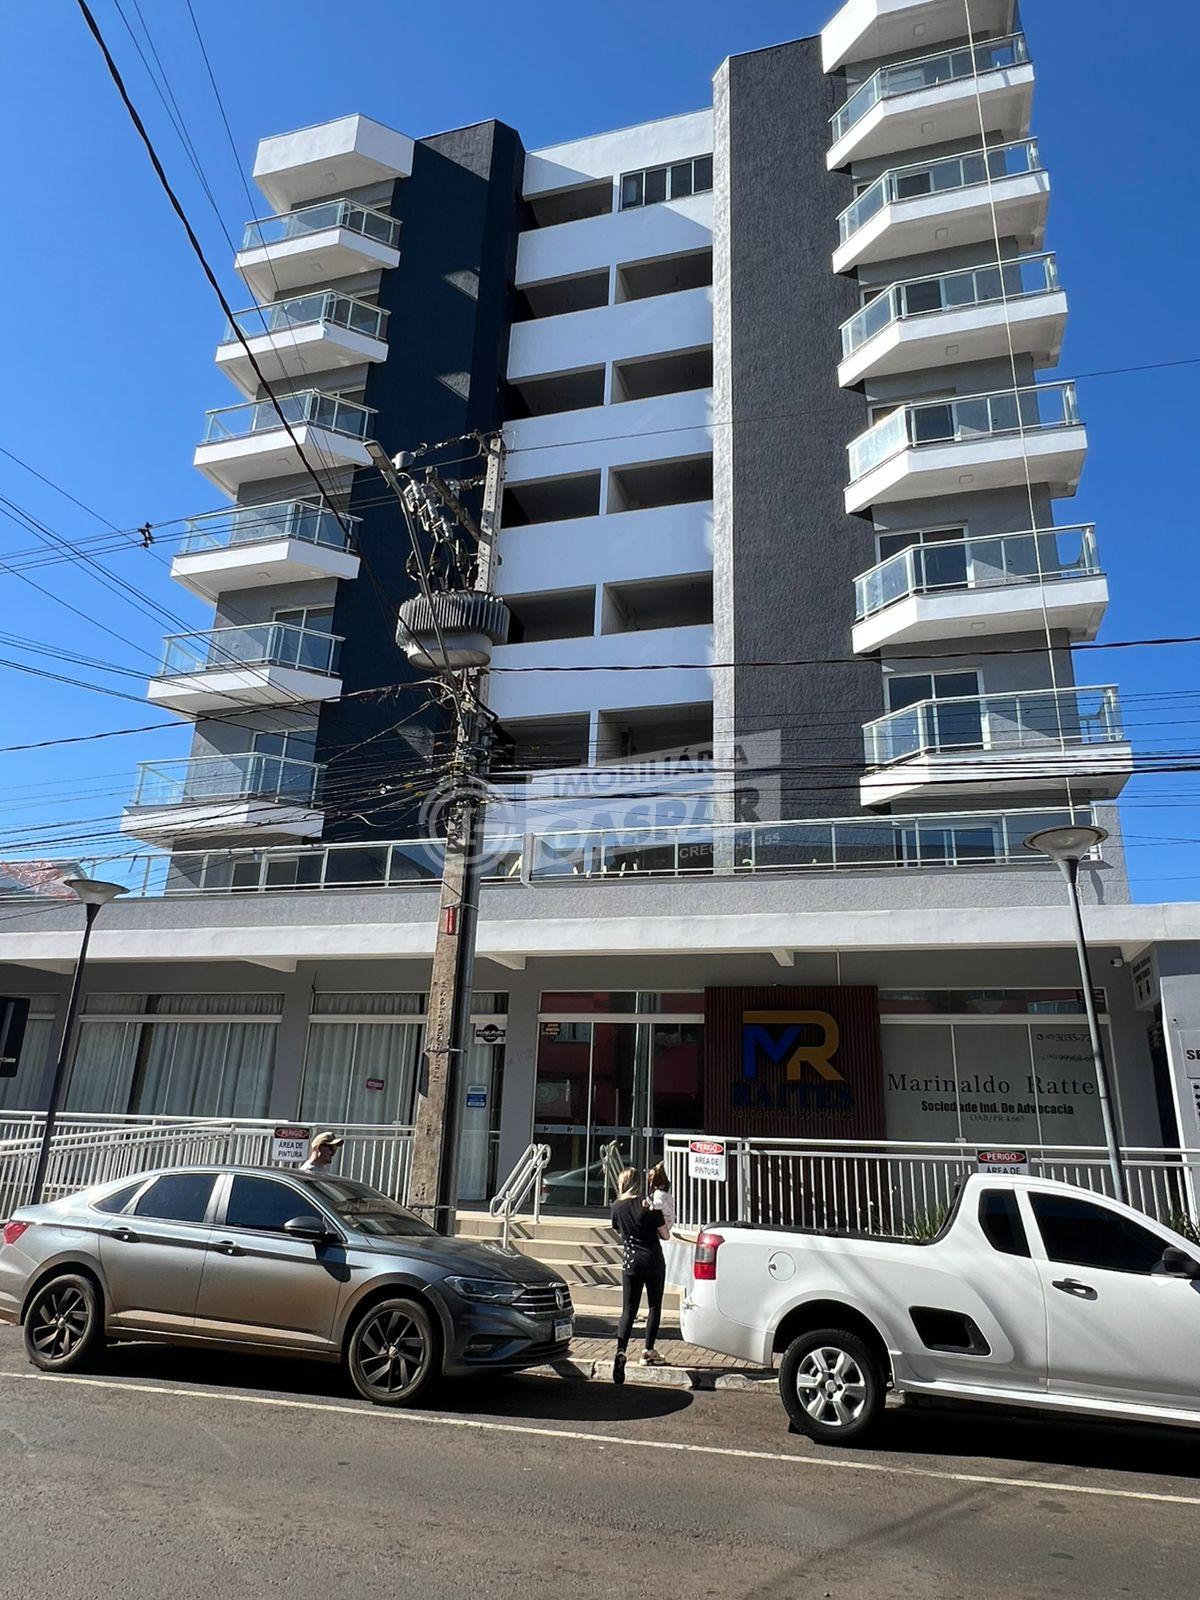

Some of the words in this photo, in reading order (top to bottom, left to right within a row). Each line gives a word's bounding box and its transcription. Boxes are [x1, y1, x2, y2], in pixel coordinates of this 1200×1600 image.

[742, 1010, 845, 1080] MR
[887, 1074, 1010, 1094] Marinaldo
[1026, 1076, 1099, 1095] Ratte
[921, 1101, 978, 1113] Sociedade
[980, 1103, 999, 1113] Ind.
[1001, 1103, 1015, 1114] De
[1017, 1103, 1074, 1115] Advocacia
[281, 1128, 303, 1138] PERIGO
[986, 1152, 1017, 1161] PERIGO
[711, 1158, 720, 1166] DE
[695, 1166, 720, 1176] PINTURA
[1010, 1167, 1021, 1175] DE
